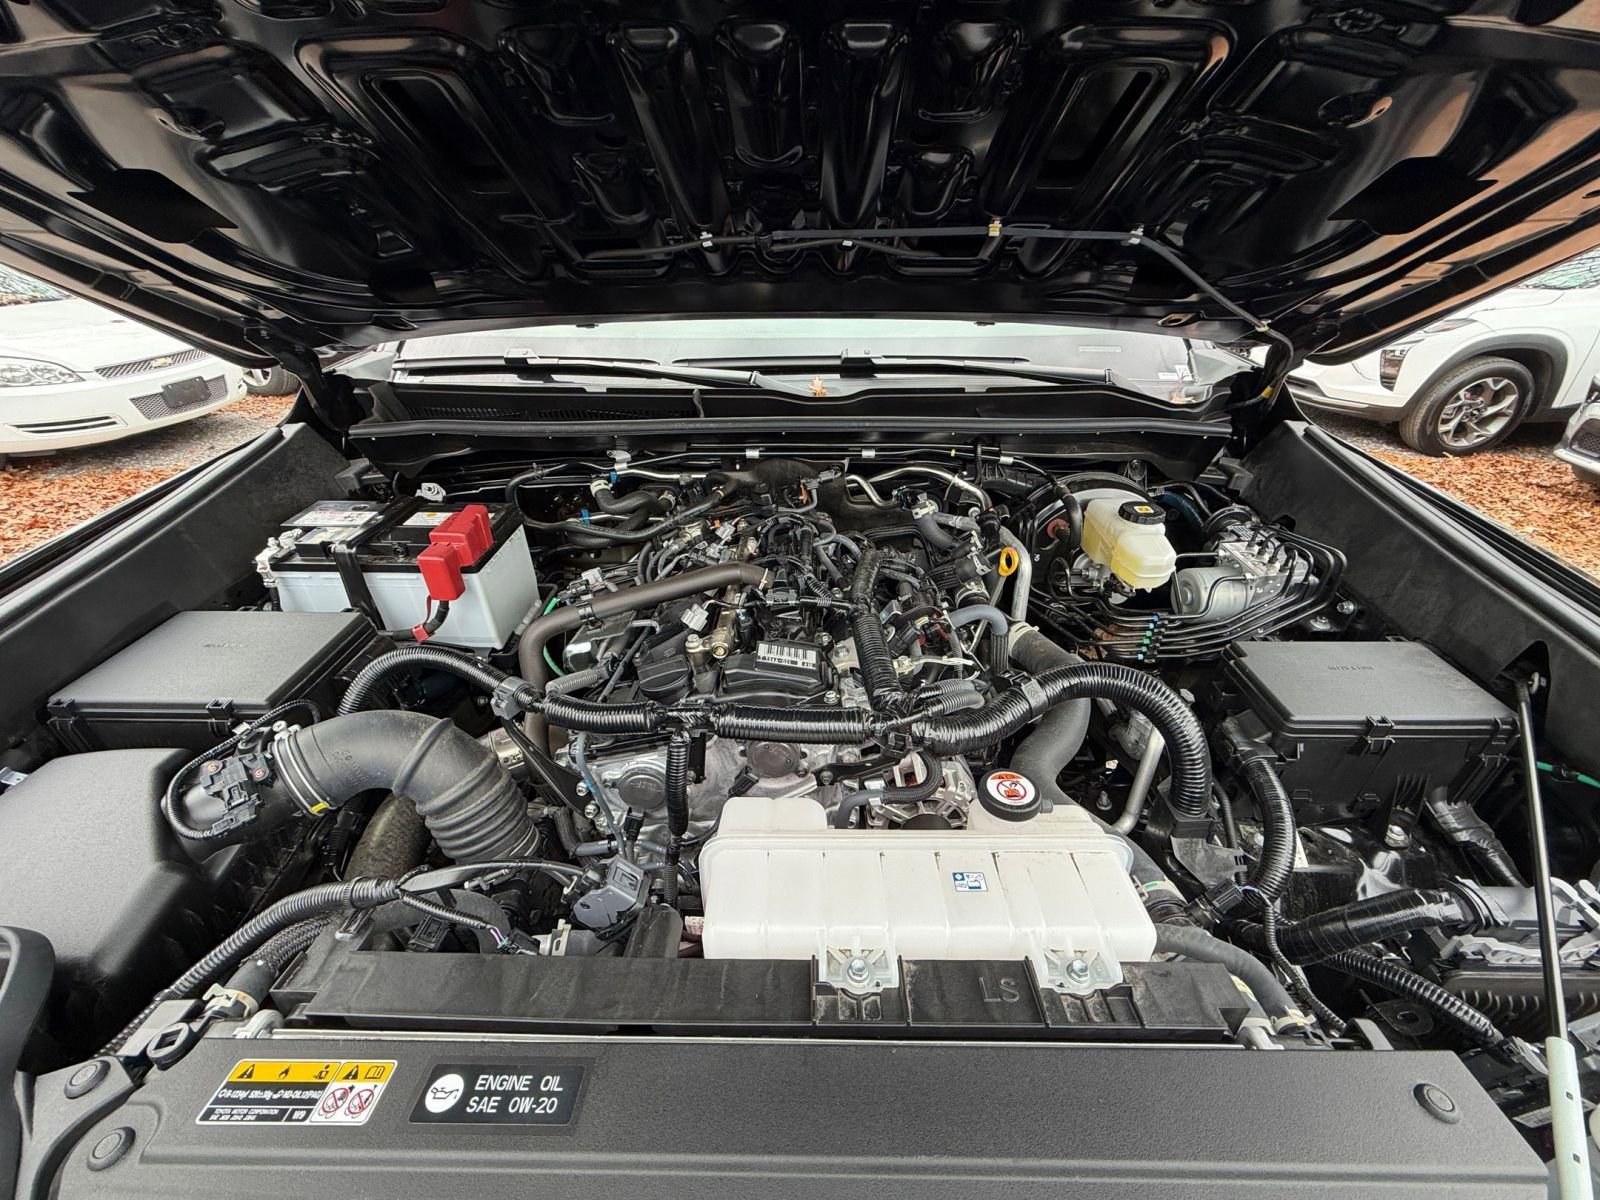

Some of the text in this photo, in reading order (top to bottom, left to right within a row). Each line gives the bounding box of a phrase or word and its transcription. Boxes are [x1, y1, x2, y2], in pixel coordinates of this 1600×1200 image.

[979, 977, 1020, 1002] LS
[474, 1075, 564, 1091] ENGINE OIL
[466, 1096, 558, 1114] SAE 0W-20
